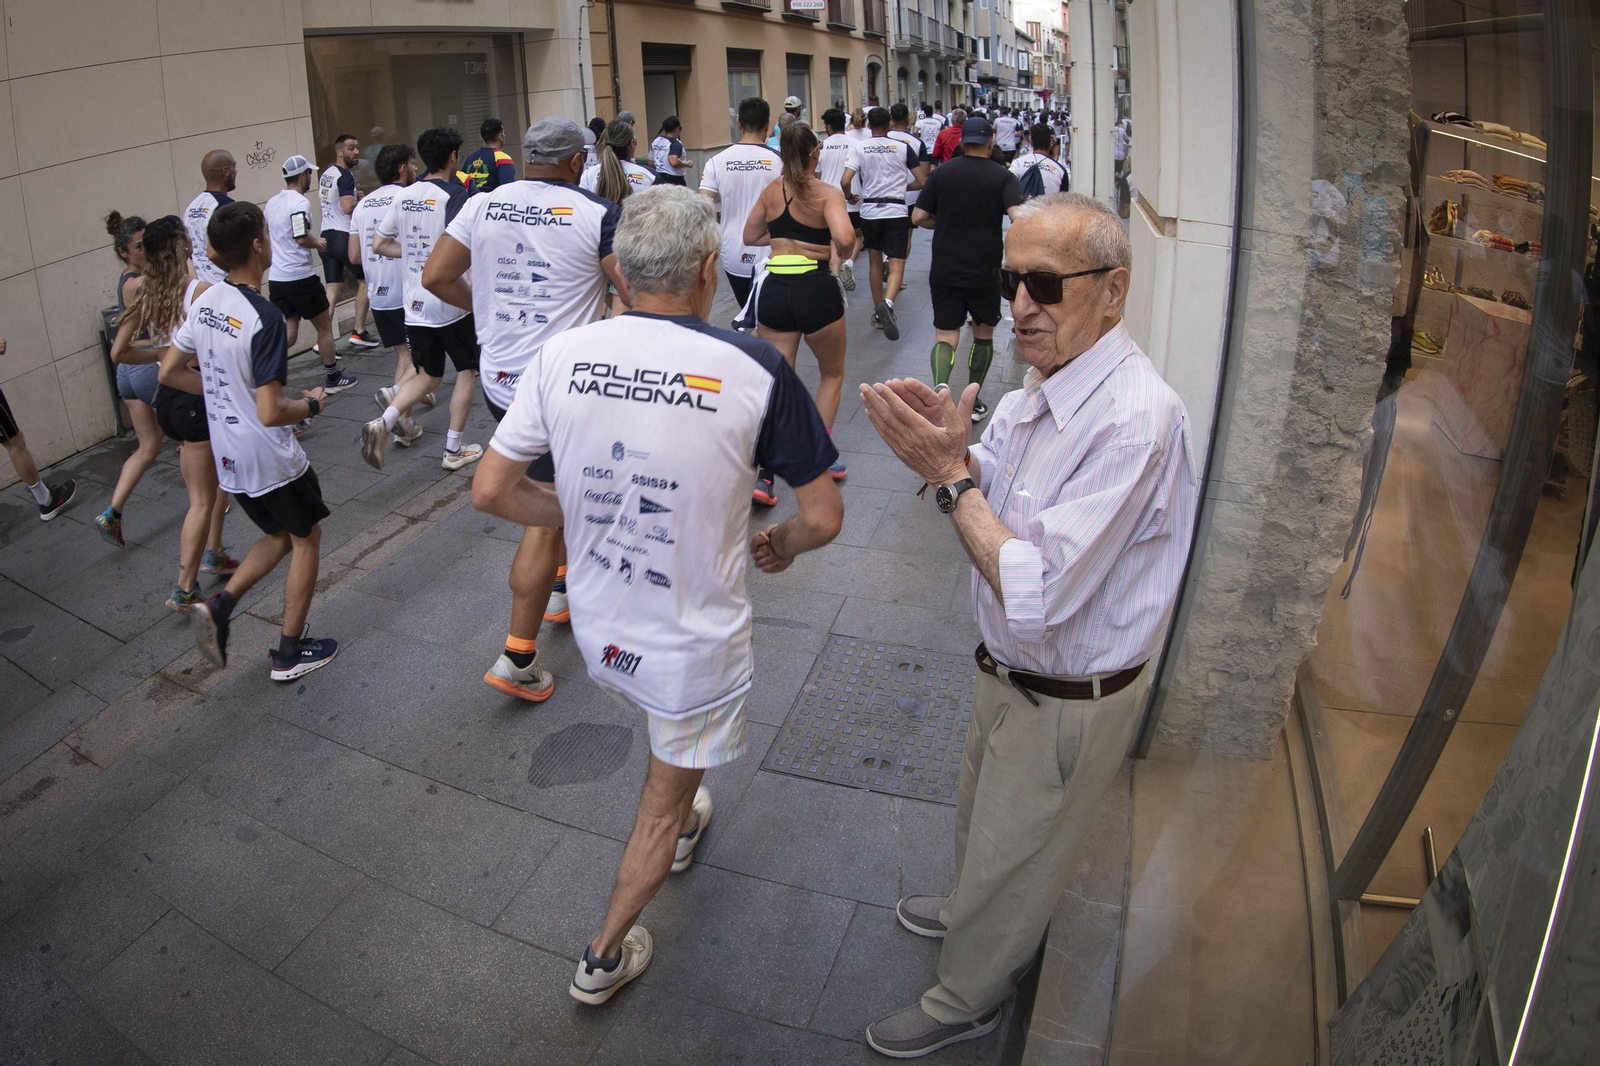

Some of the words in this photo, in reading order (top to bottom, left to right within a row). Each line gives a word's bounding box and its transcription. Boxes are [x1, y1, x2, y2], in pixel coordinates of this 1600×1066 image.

[487, 202, 553, 215] POLICIA
[485, 212, 572, 226] NACIONAL
[497, 256, 516, 265] alsa
[572, 363, 687, 388] POLICIA
[568, 379, 717, 413] NACIONAL
[582, 465, 613, 480] alsa
